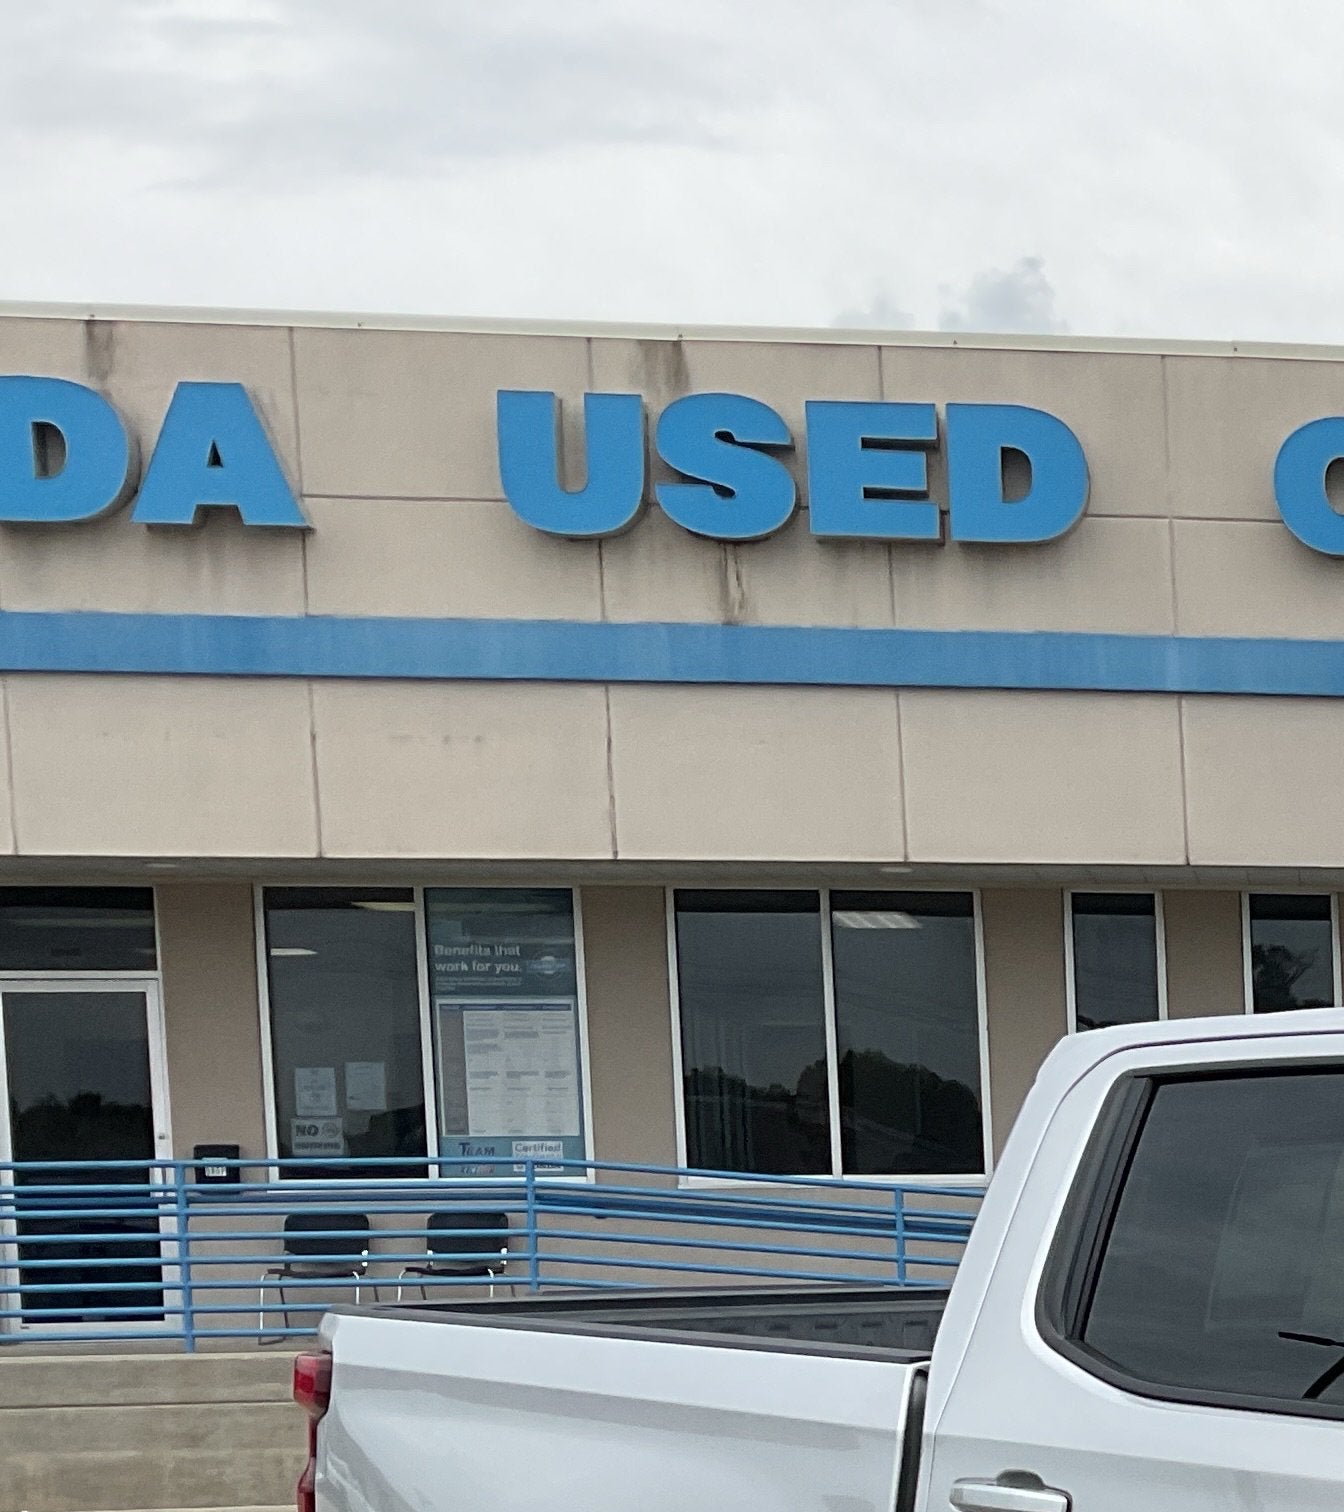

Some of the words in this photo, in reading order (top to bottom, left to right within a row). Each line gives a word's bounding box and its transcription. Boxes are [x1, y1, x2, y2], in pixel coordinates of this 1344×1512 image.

[497, 389, 1090, 543] USED
[433, 944, 491, 956] Benefits
[495, 944, 521, 957] that
[434, 960, 468, 972] work
[472, 959, 491, 972] for
[514, 1142, 562, 1153] Certified
